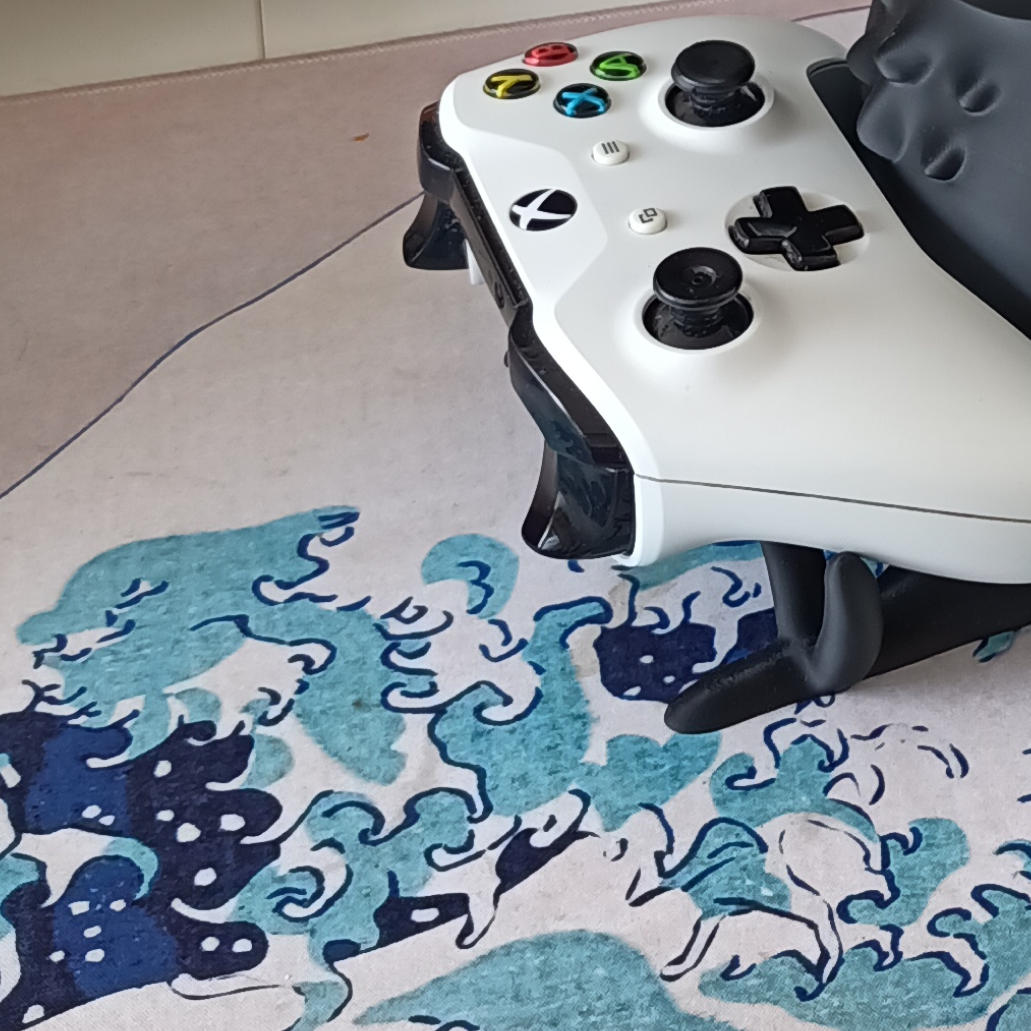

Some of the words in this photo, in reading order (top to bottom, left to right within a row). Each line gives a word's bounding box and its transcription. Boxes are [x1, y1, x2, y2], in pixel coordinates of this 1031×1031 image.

[599, 54, 640, 78] A
[491, 74, 533, 98] Y
[562, 88, 606, 116] X
